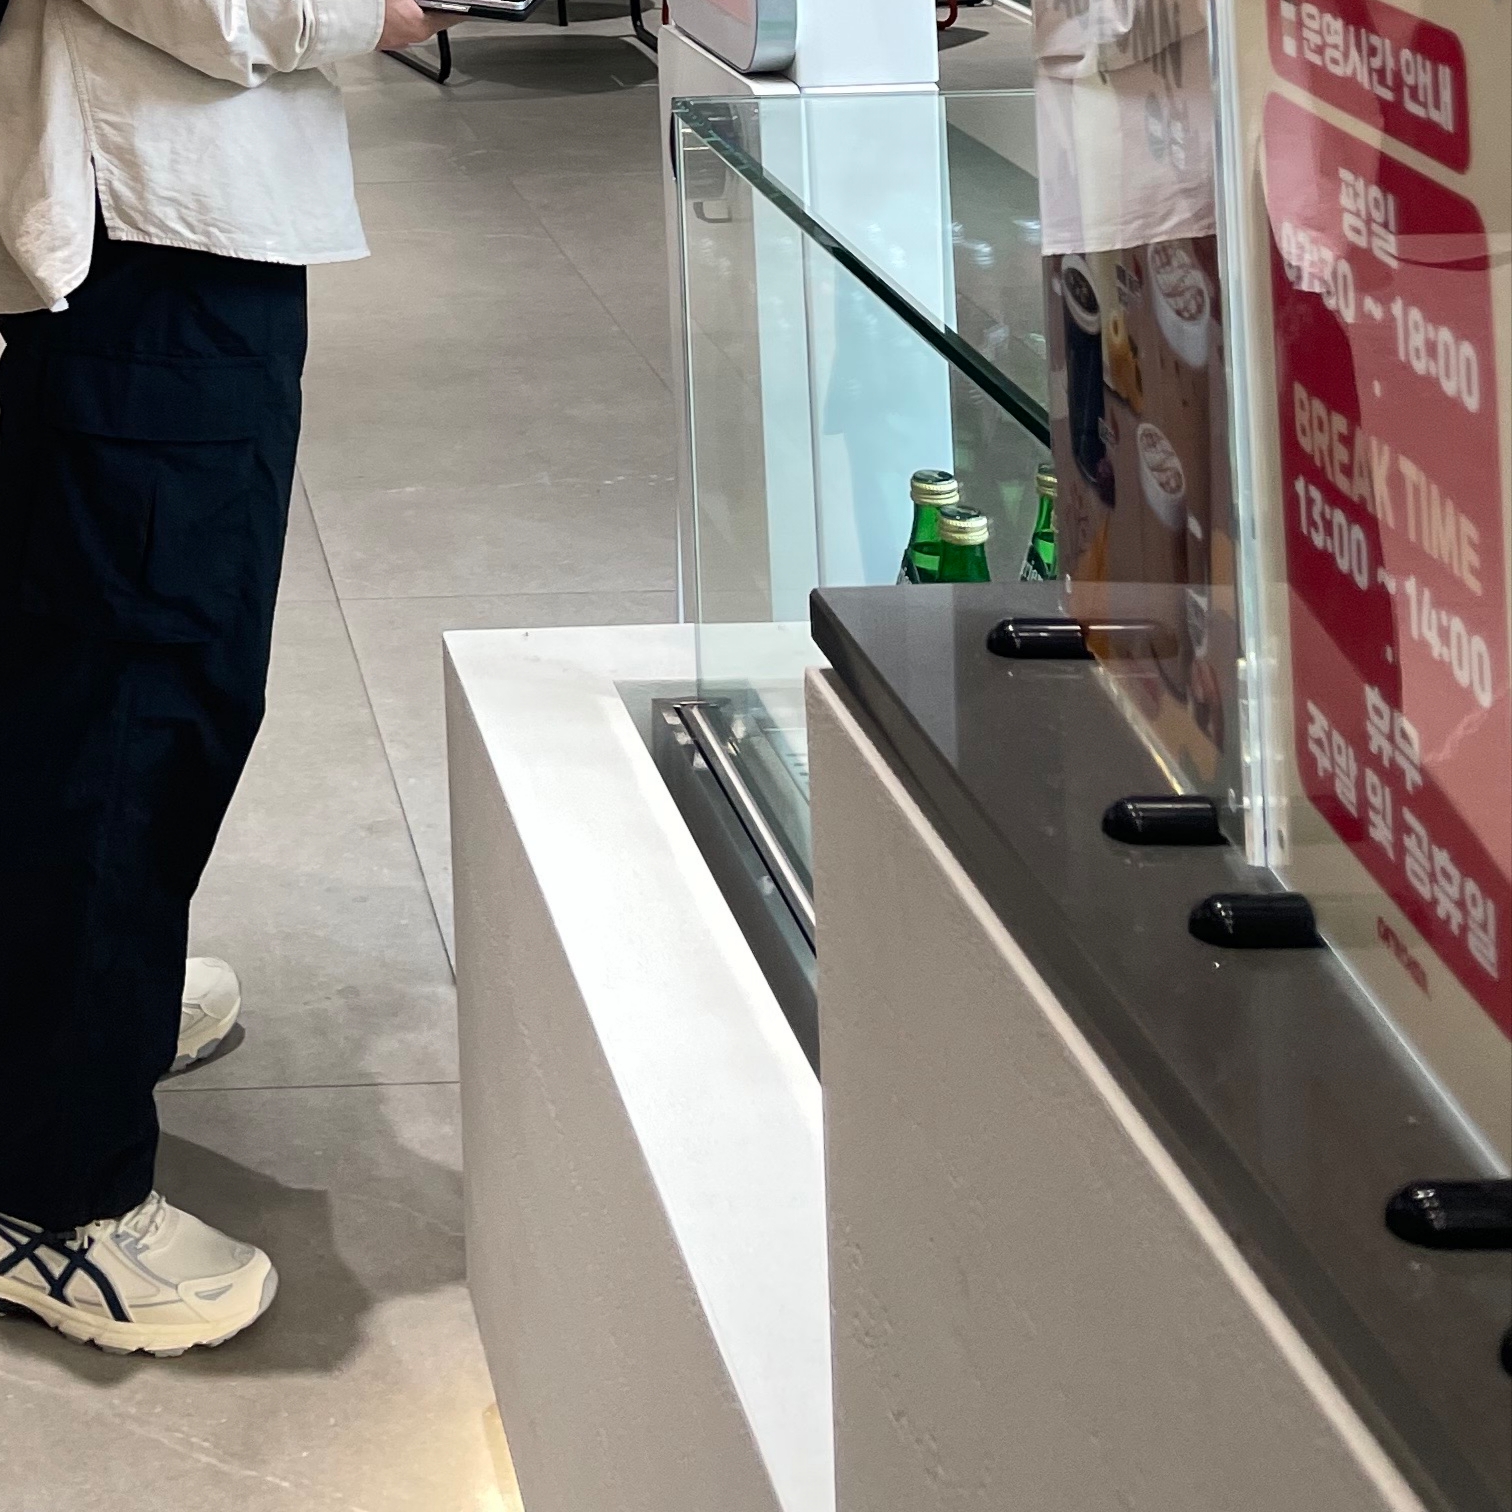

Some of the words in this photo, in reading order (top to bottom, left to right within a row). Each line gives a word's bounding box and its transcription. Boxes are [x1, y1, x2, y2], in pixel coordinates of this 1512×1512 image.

[1301, 2, 1394, 102] 운영시간
[1399, 48, 1455, 134] 안내
[1338, 167, 1399, 269] 평일
[1391, 296, 1480, 413] 18:00
[1294, 381, 1395, 530] BREAK
[1399, 454, 1482, 596] TIME
[1295, 475, 1368, 591] 13:00
[1405, 575, 1493, 708] 14:00
[1364, 684, 1423, 795] 휴무
[1307, 700, 1359, 819] 주말
[1365, 768, 1396, 862] 및
[1402, 807, 1500, 980] 공휴일
